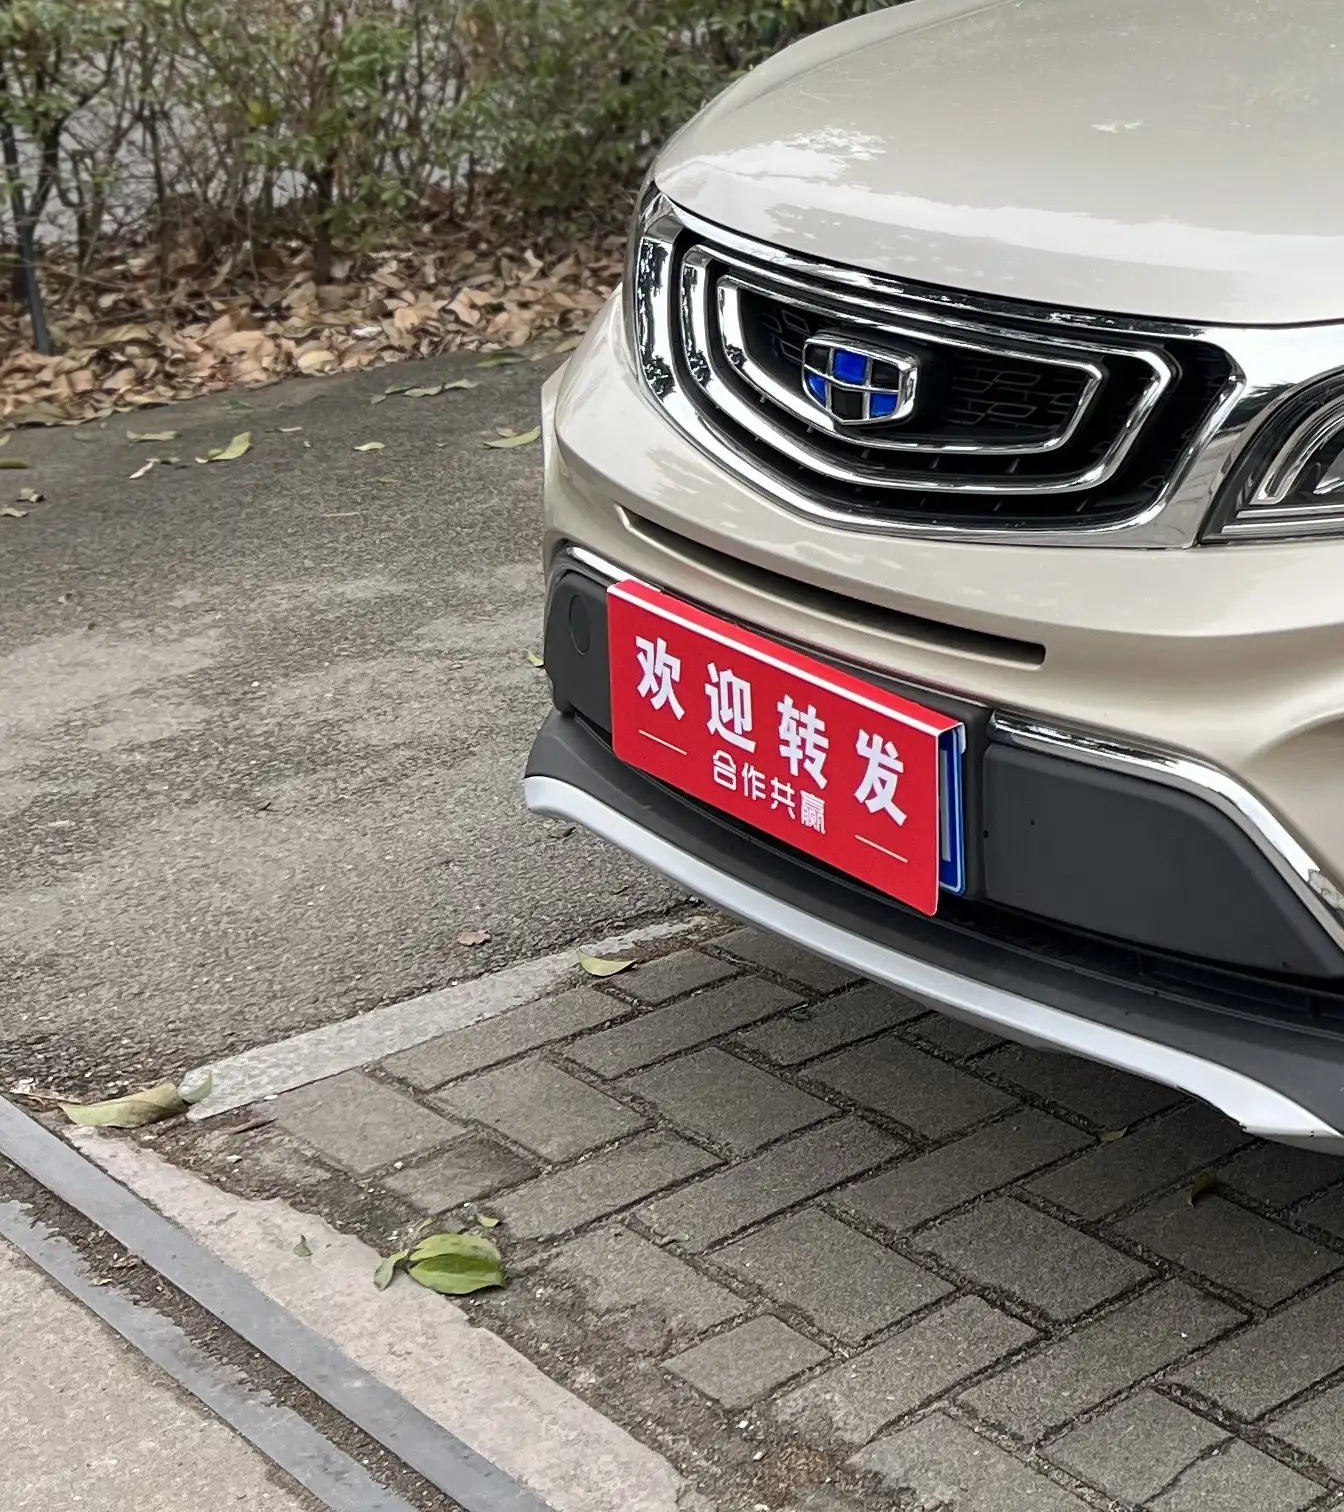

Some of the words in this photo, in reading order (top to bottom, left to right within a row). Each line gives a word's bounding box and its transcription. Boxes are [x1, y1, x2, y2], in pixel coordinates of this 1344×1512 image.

[635, 634, 908, 827] 欢迎转发
[712, 749, 827, 836] 合作共赢
